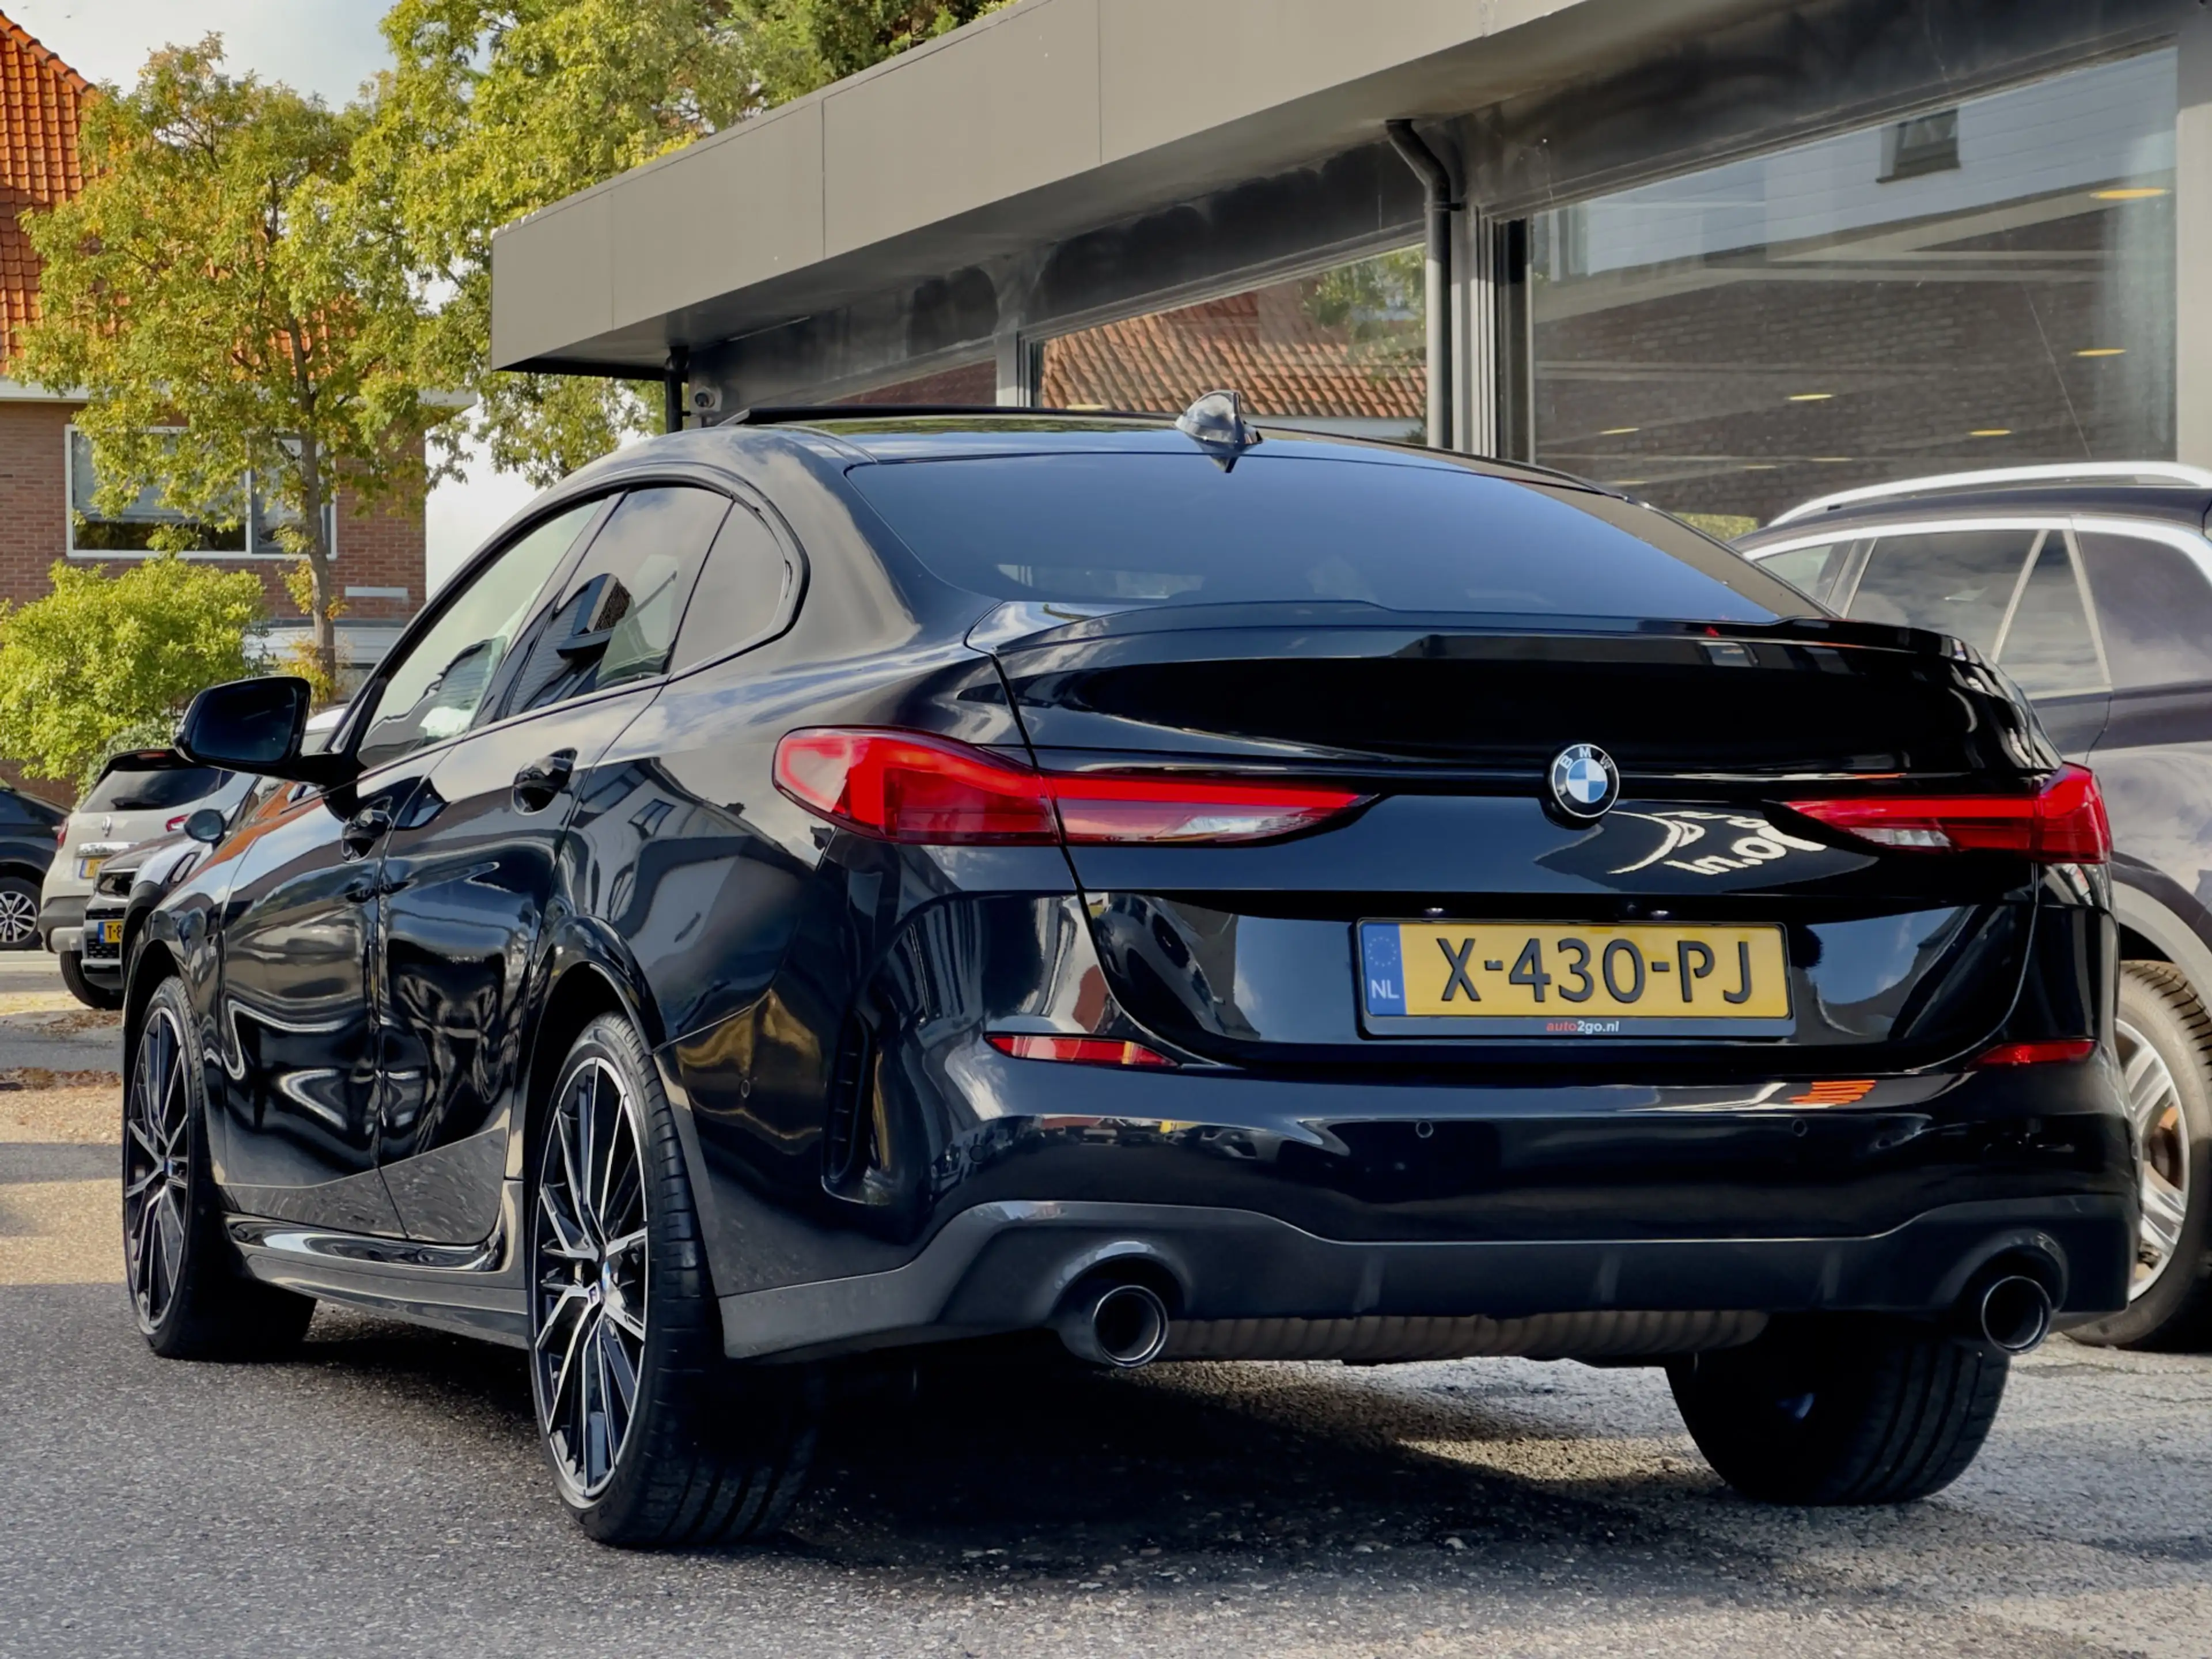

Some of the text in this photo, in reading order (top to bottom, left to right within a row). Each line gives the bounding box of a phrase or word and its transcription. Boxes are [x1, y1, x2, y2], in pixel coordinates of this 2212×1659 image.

[1559, 747, 1612, 770] BMW
[1436, 938, 1752, 1004] X-430-PJ
[1371, 979, 1400, 999] NL
[1546, 1020, 1619, 1035] auto2go.nl
